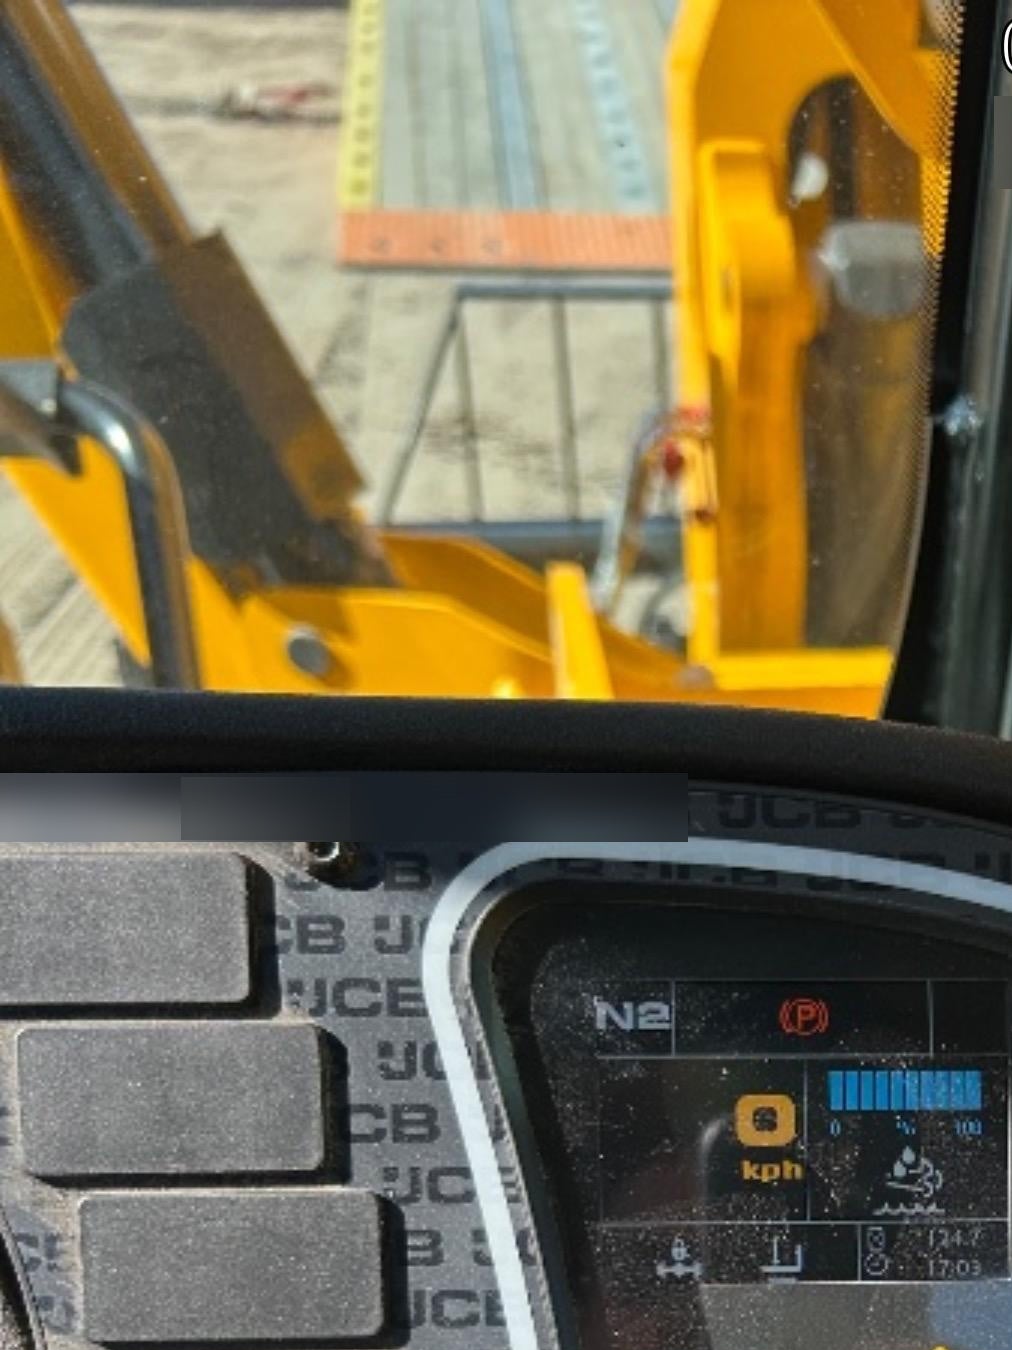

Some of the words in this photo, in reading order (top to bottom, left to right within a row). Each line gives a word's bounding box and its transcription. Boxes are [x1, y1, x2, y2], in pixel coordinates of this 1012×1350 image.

[596, 1001, 673, 1031] N2
[350, 1103, 441, 1143] CB
[734, 1094, 797, 1148] 0
[829, 1120, 841, 1136] 0
[741, 1160, 804, 1182] kph
[928, 1259, 982, 1276] 17:03
